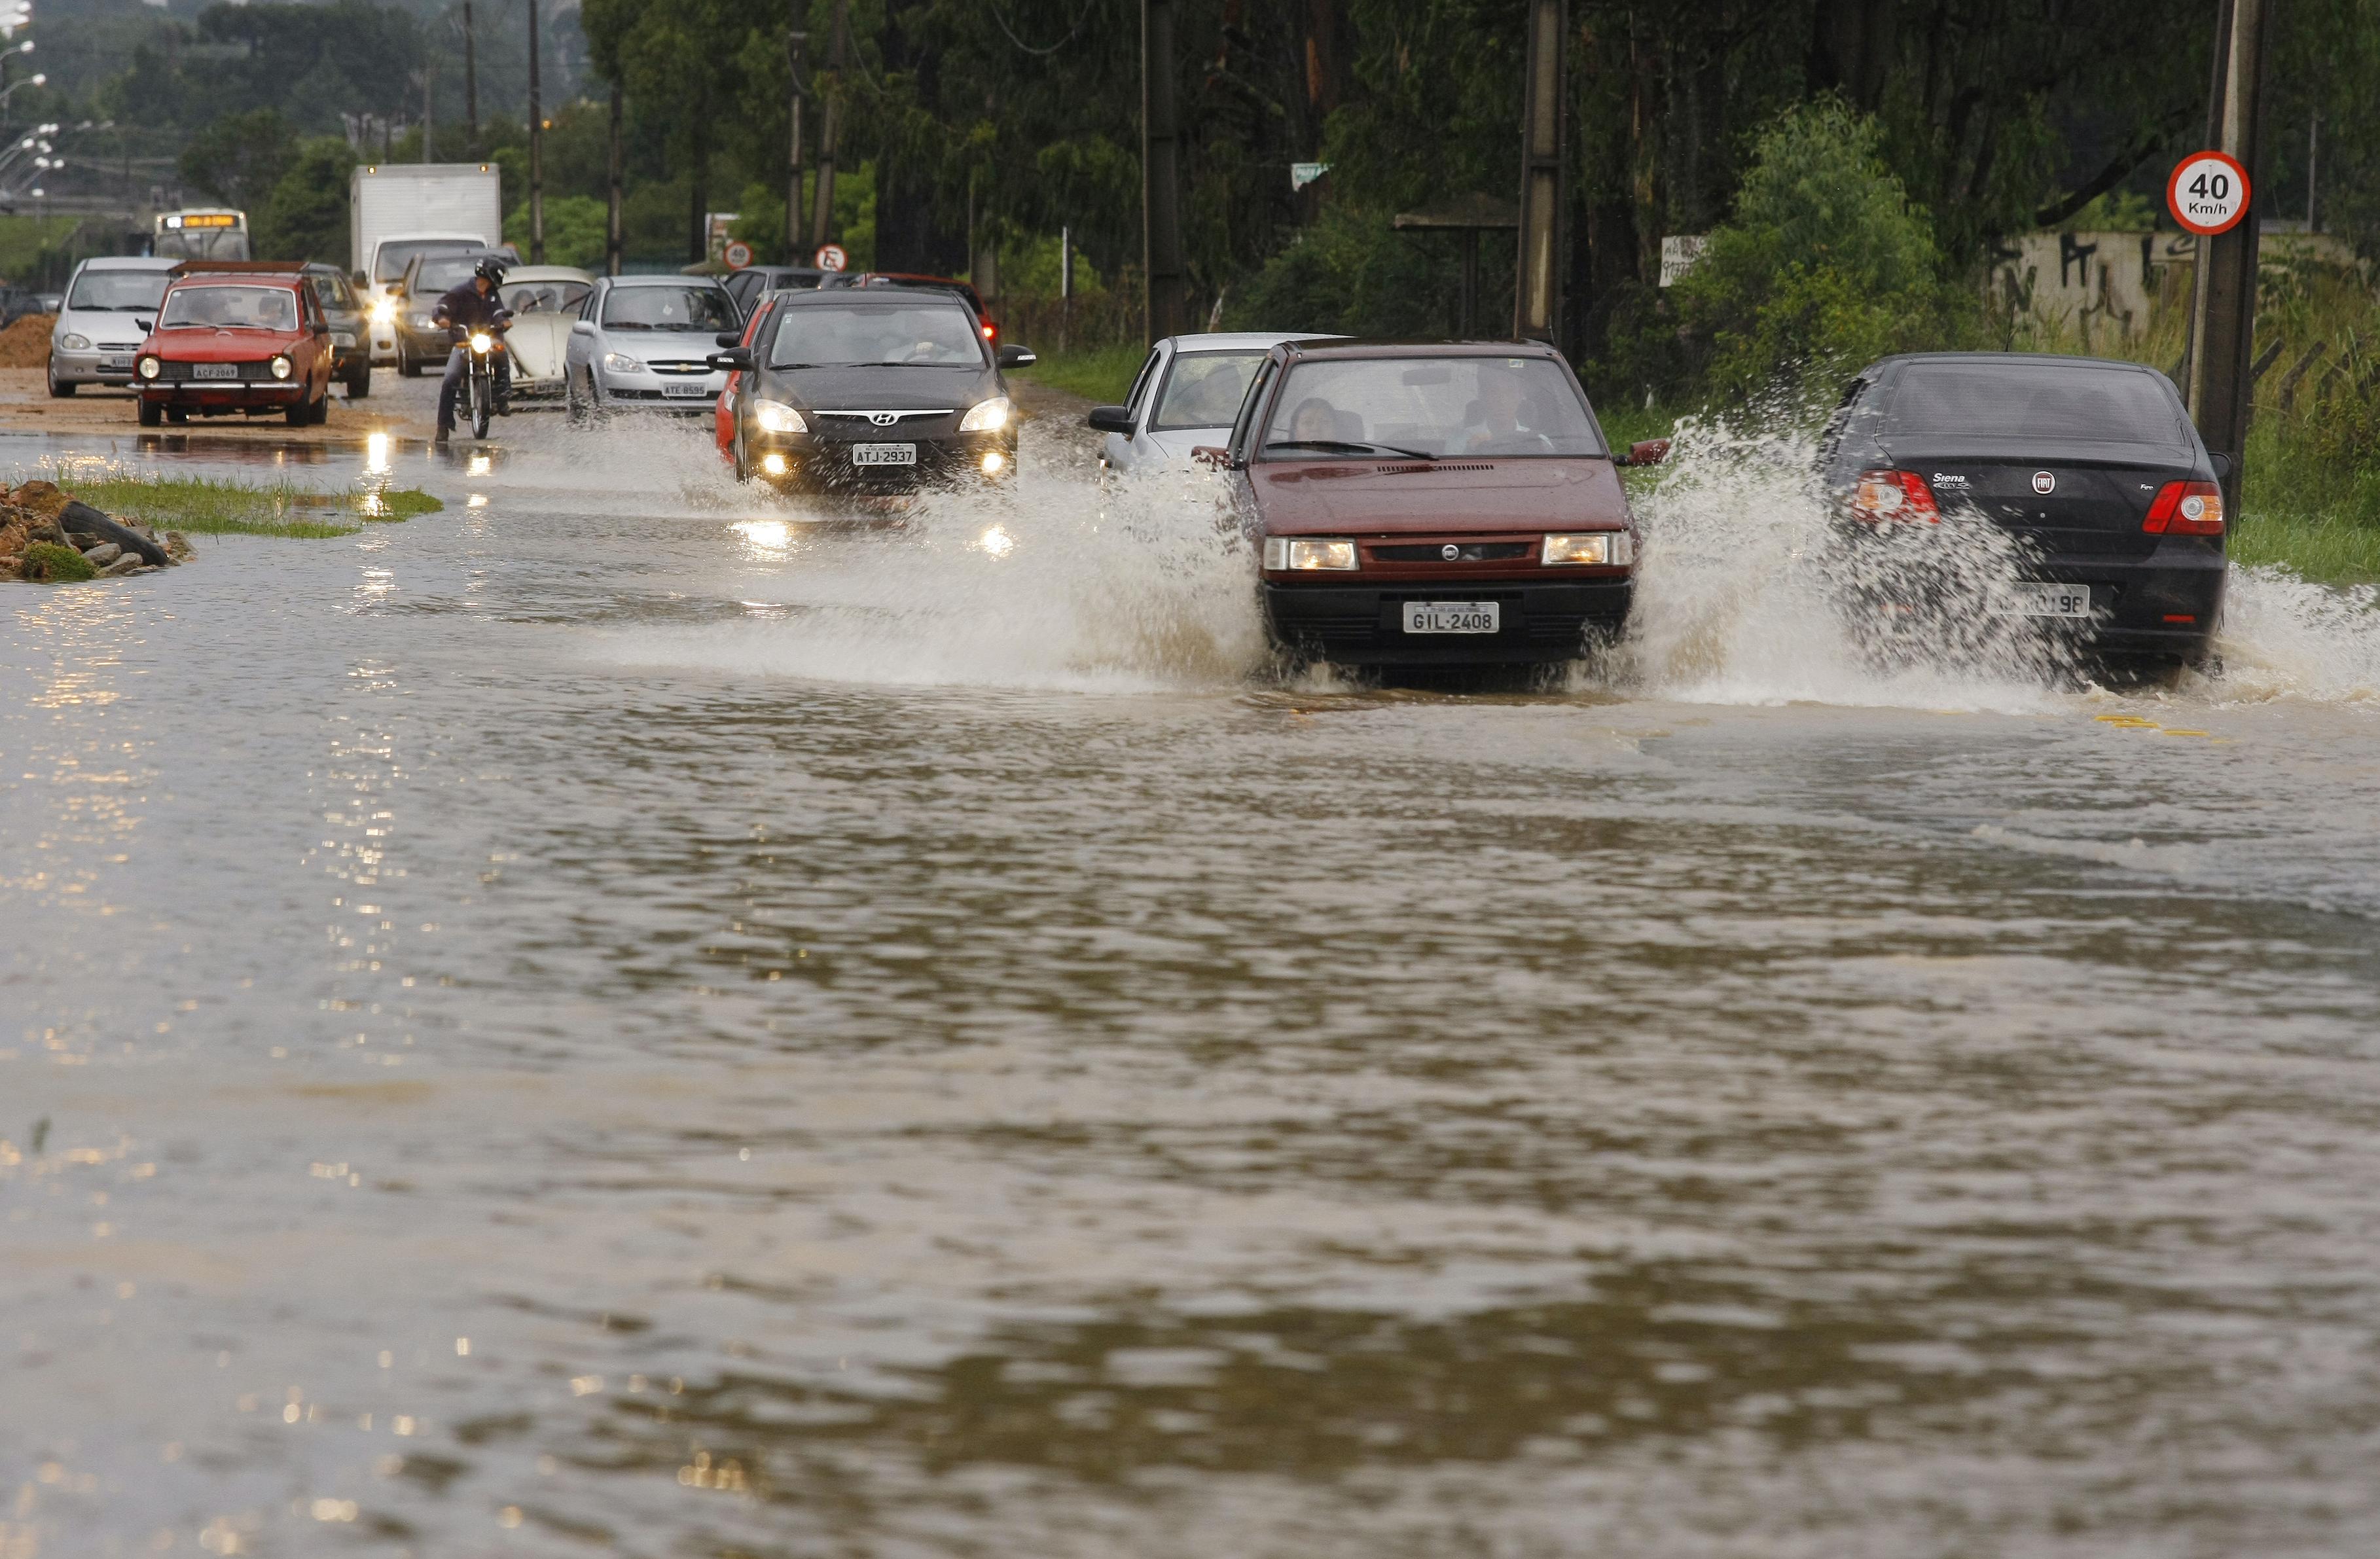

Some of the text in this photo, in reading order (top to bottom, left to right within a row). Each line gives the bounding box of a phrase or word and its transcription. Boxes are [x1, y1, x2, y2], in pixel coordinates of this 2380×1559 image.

[2189, 173, 2229, 200] 40
[2189, 202, 2227, 215] Km/h
[1932, 473, 1965, 482] Siena
[2036, 478, 2051, 488] FIAT
